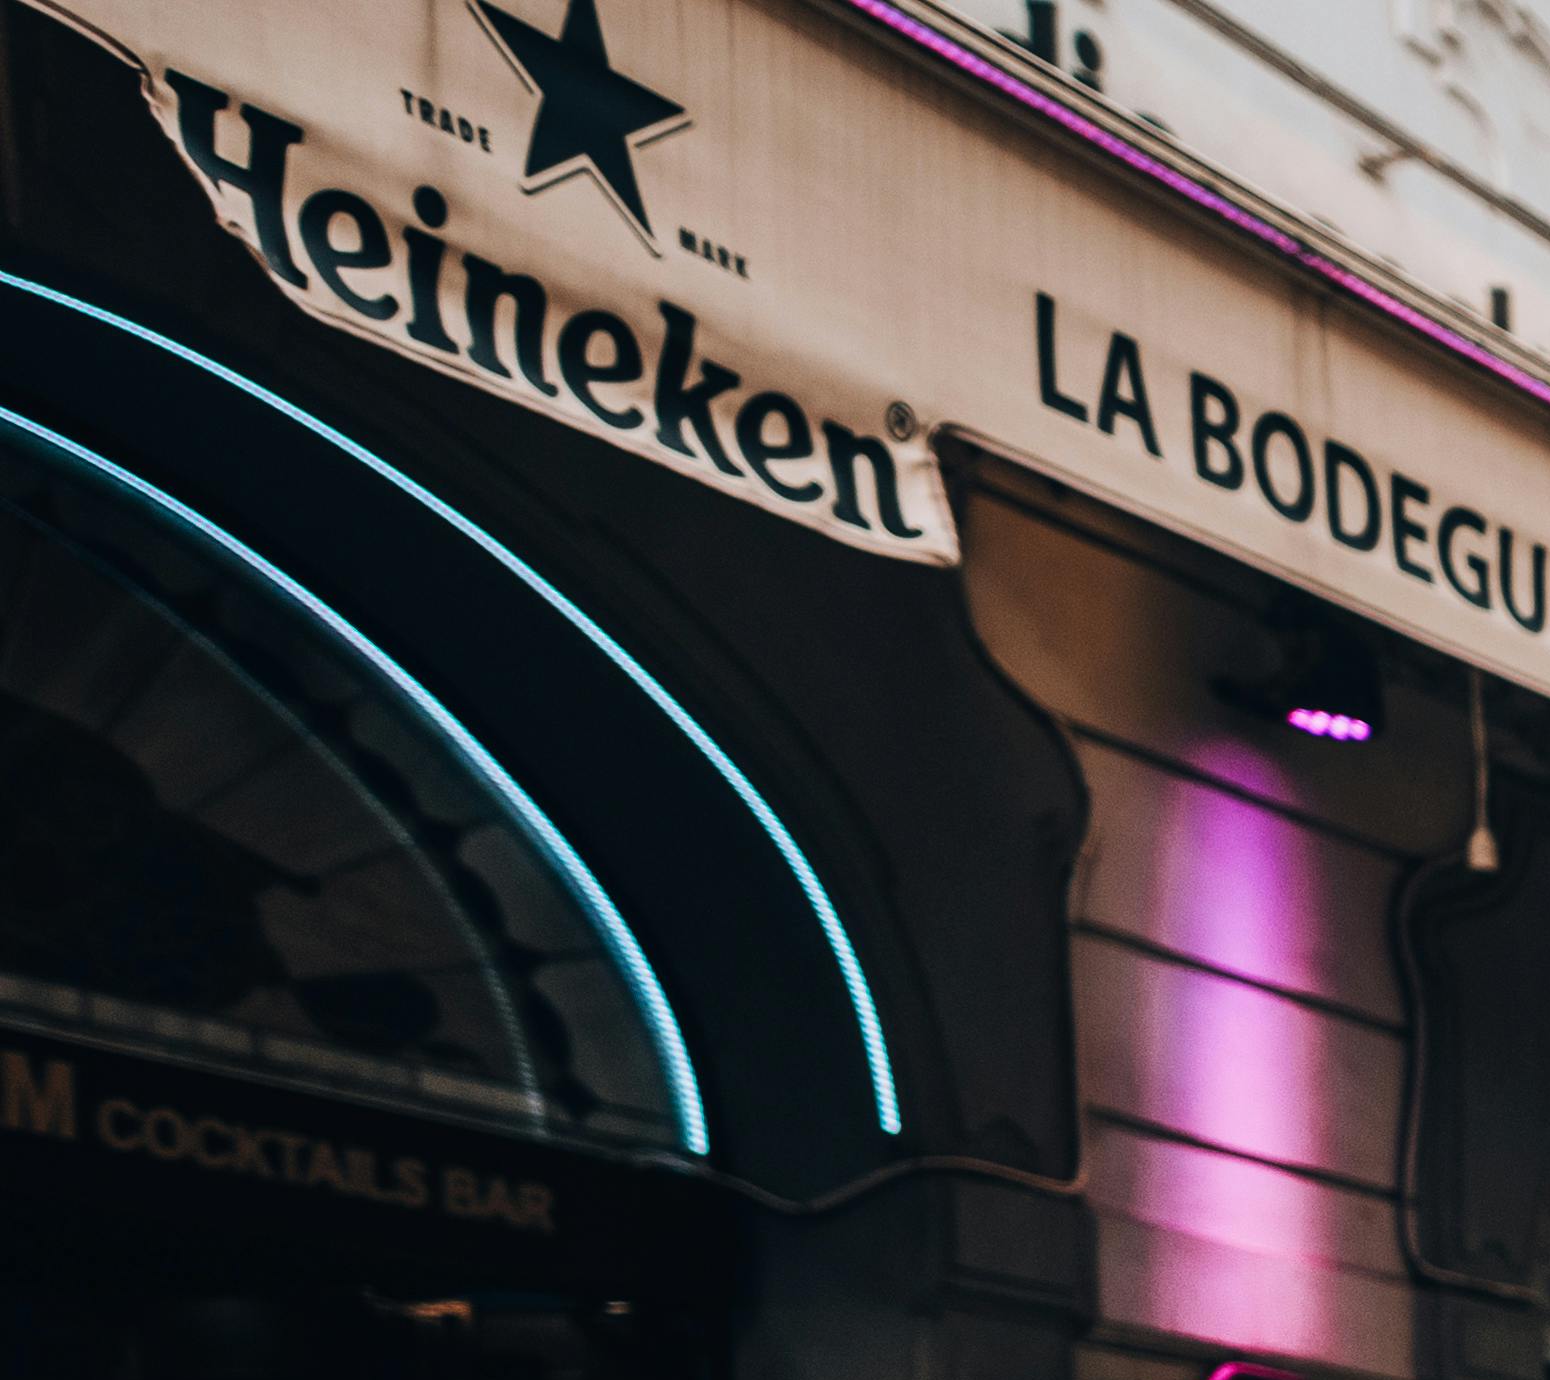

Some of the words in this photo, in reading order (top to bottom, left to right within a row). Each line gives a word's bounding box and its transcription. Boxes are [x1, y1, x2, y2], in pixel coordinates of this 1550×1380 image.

[400, 87, 494, 154] TRADE
[677, 225, 751, 280] MARK
[164, 67, 925, 540] Heineken
[1035, 290, 1163, 459] LA
[95, 1096, 430, 1211] COCKTAILS
[440, 1163, 559, 1236] BAR
